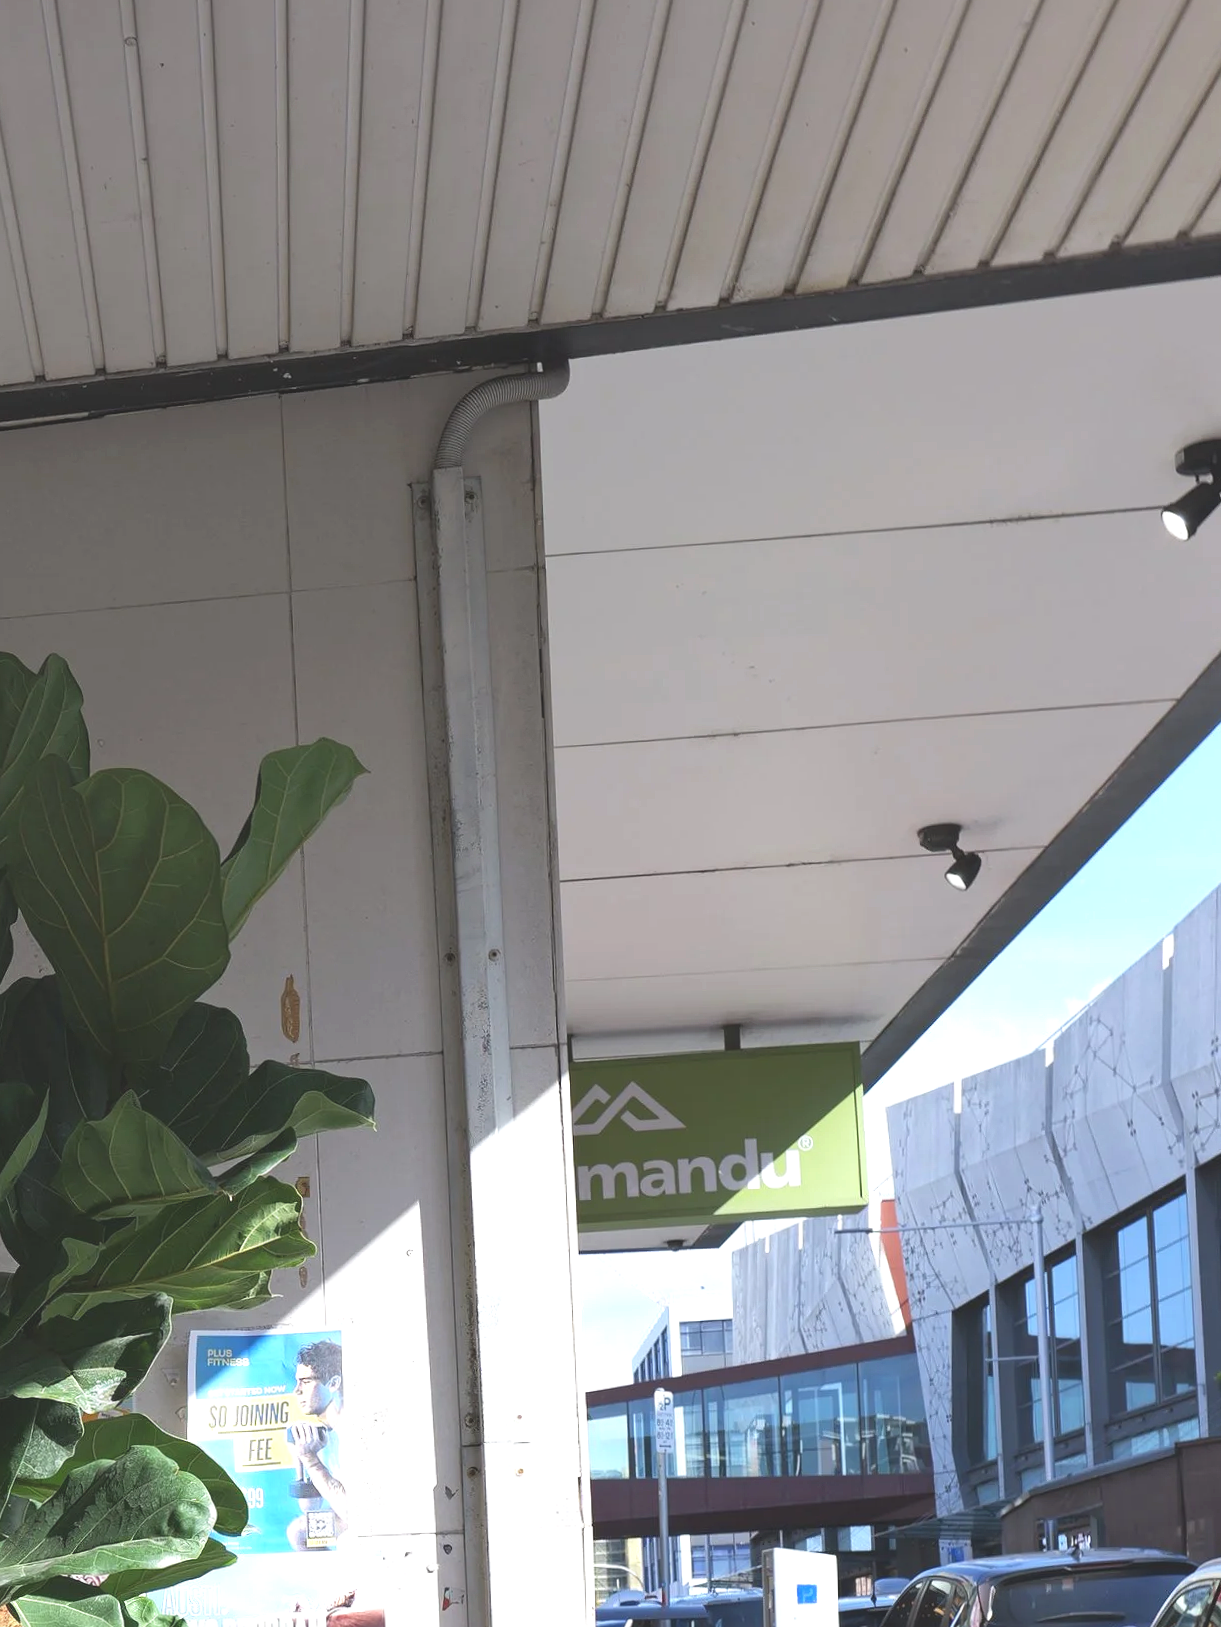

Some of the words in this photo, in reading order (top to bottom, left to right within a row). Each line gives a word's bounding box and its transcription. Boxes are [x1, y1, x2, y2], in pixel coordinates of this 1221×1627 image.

[577, 1138, 802, 1200] mandu
[207, 1349, 232, 1358] PLUS
[207, 1358, 250, 1367] FITNESS
[264, 1385, 286, 1394] NOW
[233, 1401, 289, 1427] JOINING
[248, 1438, 273, 1461] FEE
